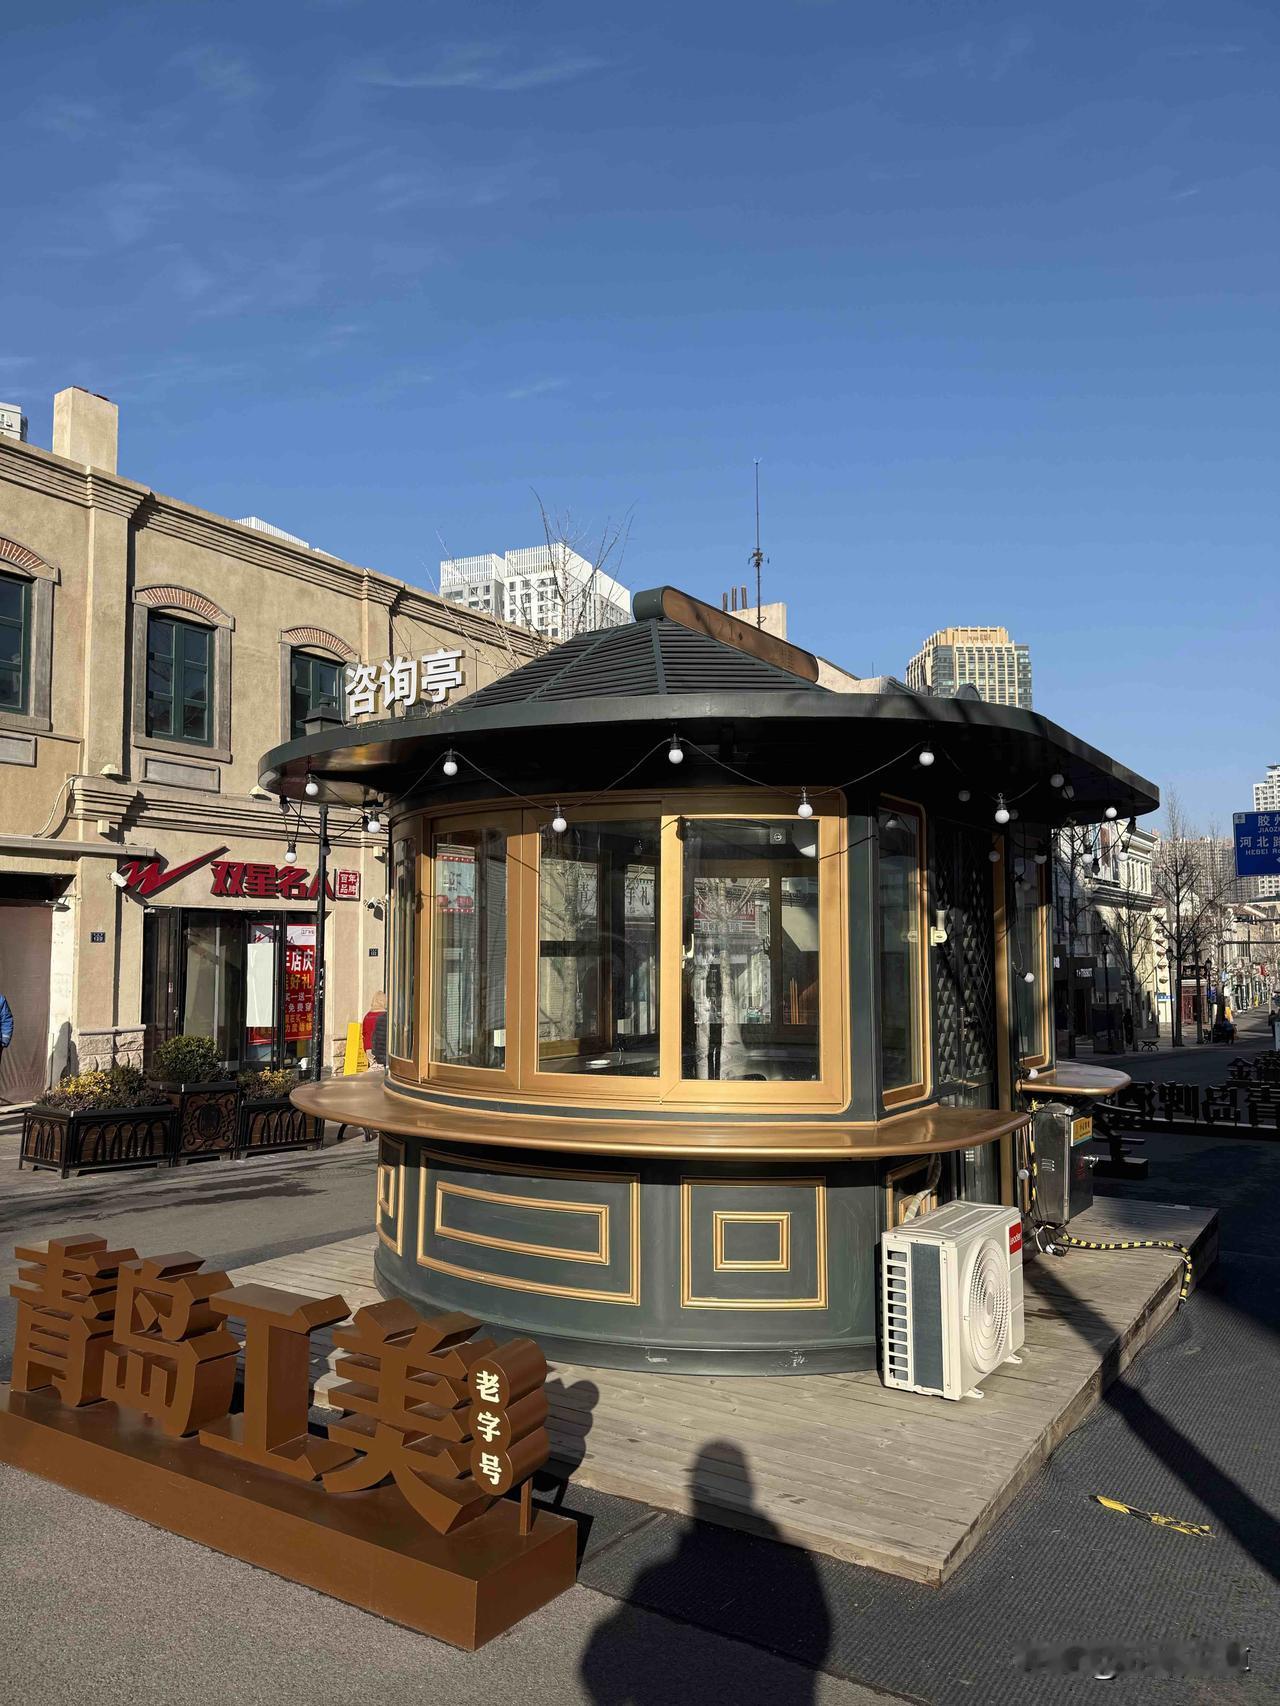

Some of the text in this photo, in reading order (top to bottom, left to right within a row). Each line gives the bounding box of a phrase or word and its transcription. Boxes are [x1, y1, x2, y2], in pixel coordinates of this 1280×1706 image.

[345, 648, 466, 717] 咨询亭
[210, 861, 336, 901] 双星名人
[340, 873, 358, 884] 百年
[340, 884, 357, 895] 品牌
[285, 1002, 312, 1013] 免费穿
[475, 1369, 505, 1486] 老字号
